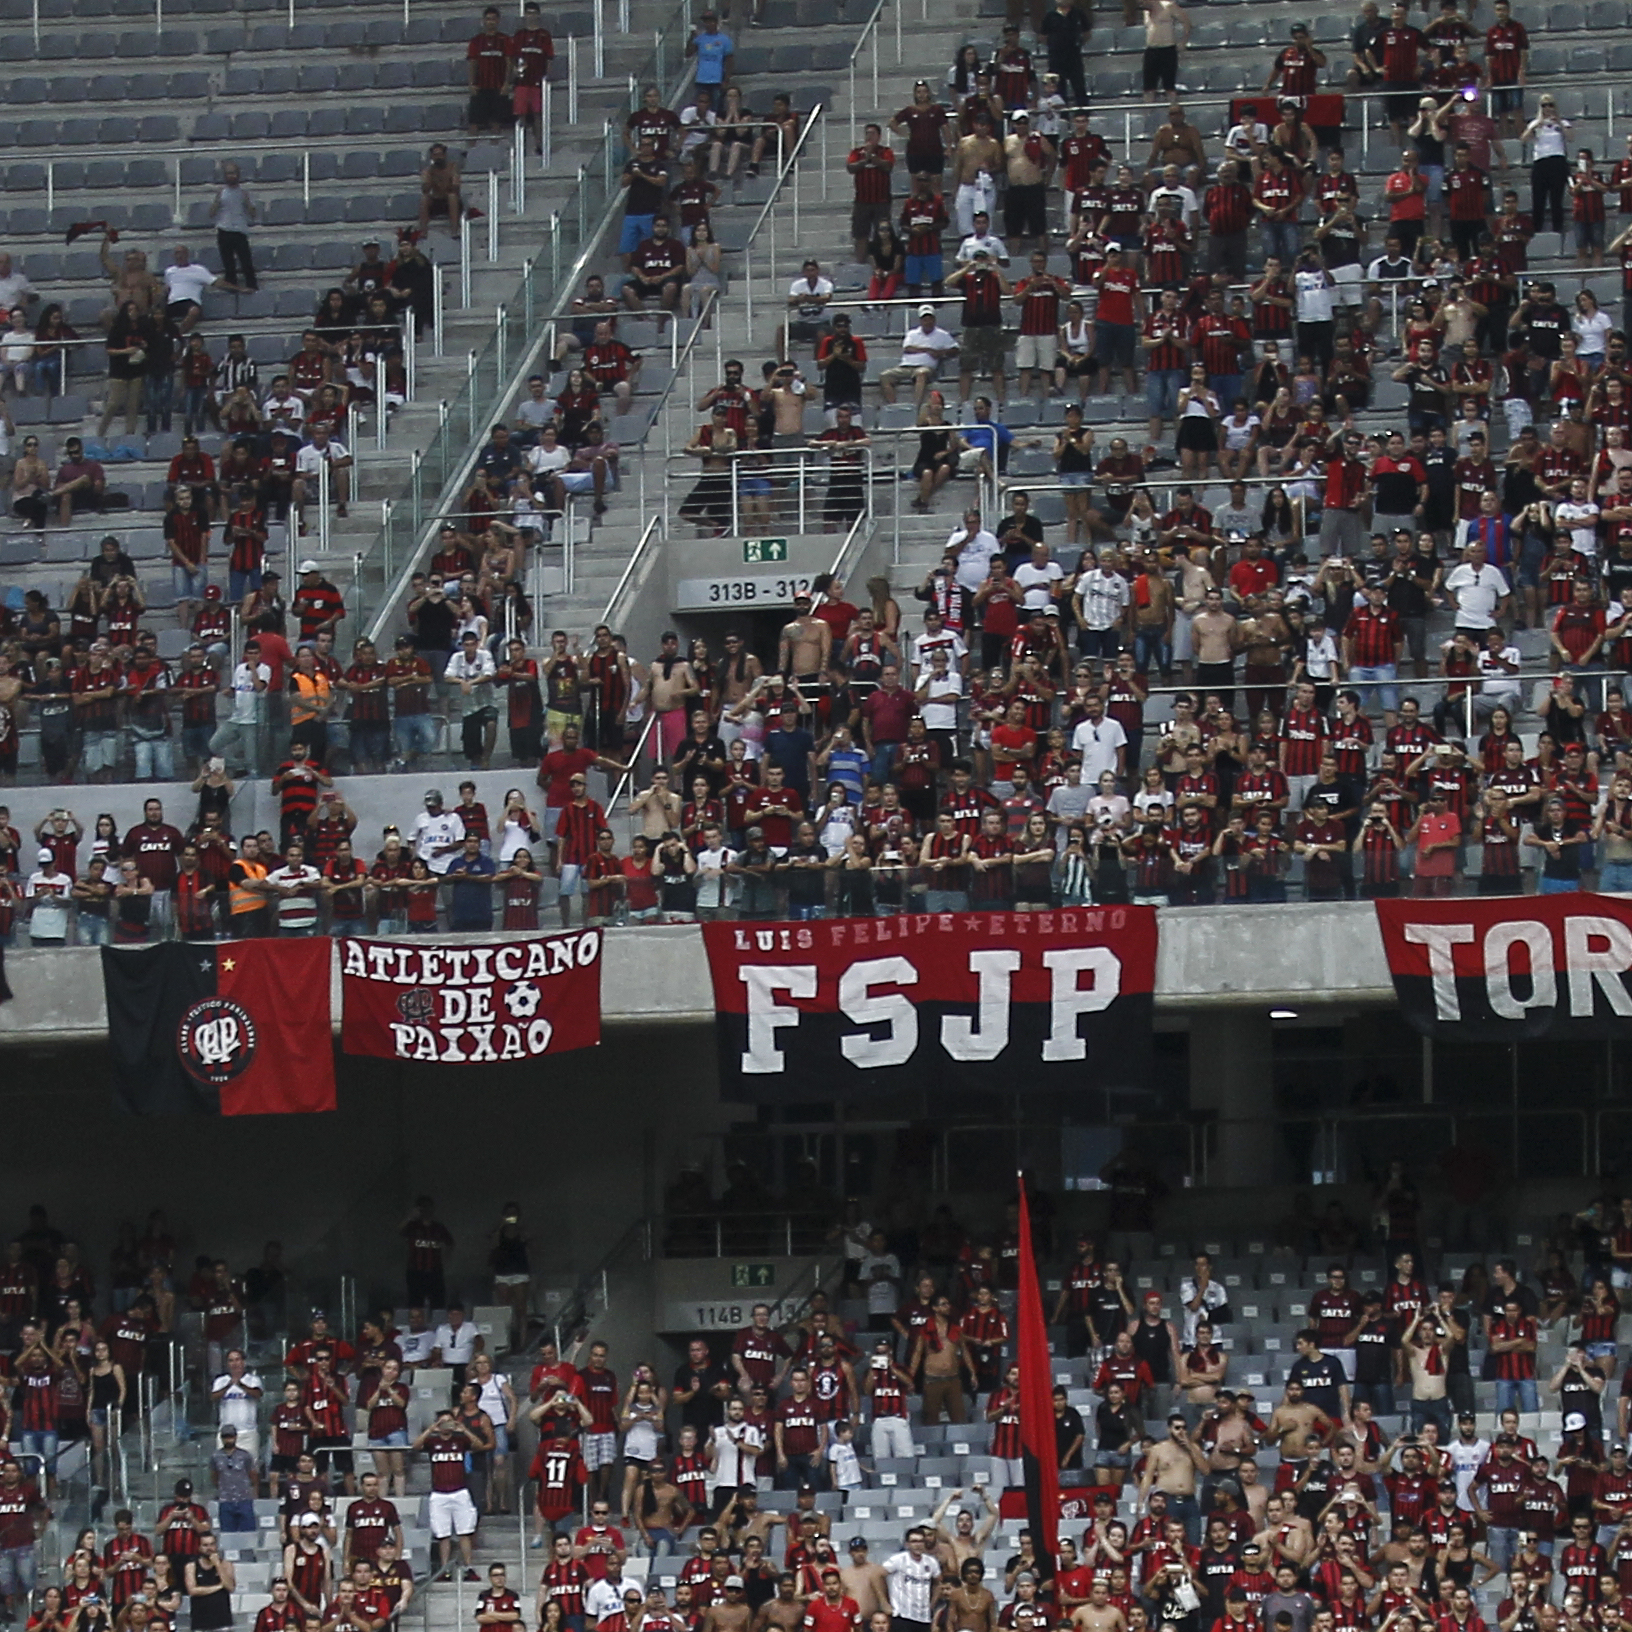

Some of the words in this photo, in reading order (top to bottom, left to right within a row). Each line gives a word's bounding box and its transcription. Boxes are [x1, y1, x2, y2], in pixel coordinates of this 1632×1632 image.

[709, 583, 757, 602] 313B
[776, 579, 810, 598] 312
[140, 843, 170, 851] CAIXA
[734, 928, 814, 951] LUIS
[831, 913, 955, 947] FELIPE
[988, 908, 1127, 936] ETERNO
[343, 929, 602, 986] ATLÉTICANO
[439, 987, 496, 1025] DE
[738, 946, 1122, 1074] FSJP
[389, 1017, 553, 1062] PAIXÃO
[697, 1306, 742, 1325] 114B
[745, 1350, 773, 1361] CAIXA
[432, 1453, 463, 1462] CAIXA
[546, 1459, 566, 1481] 11
